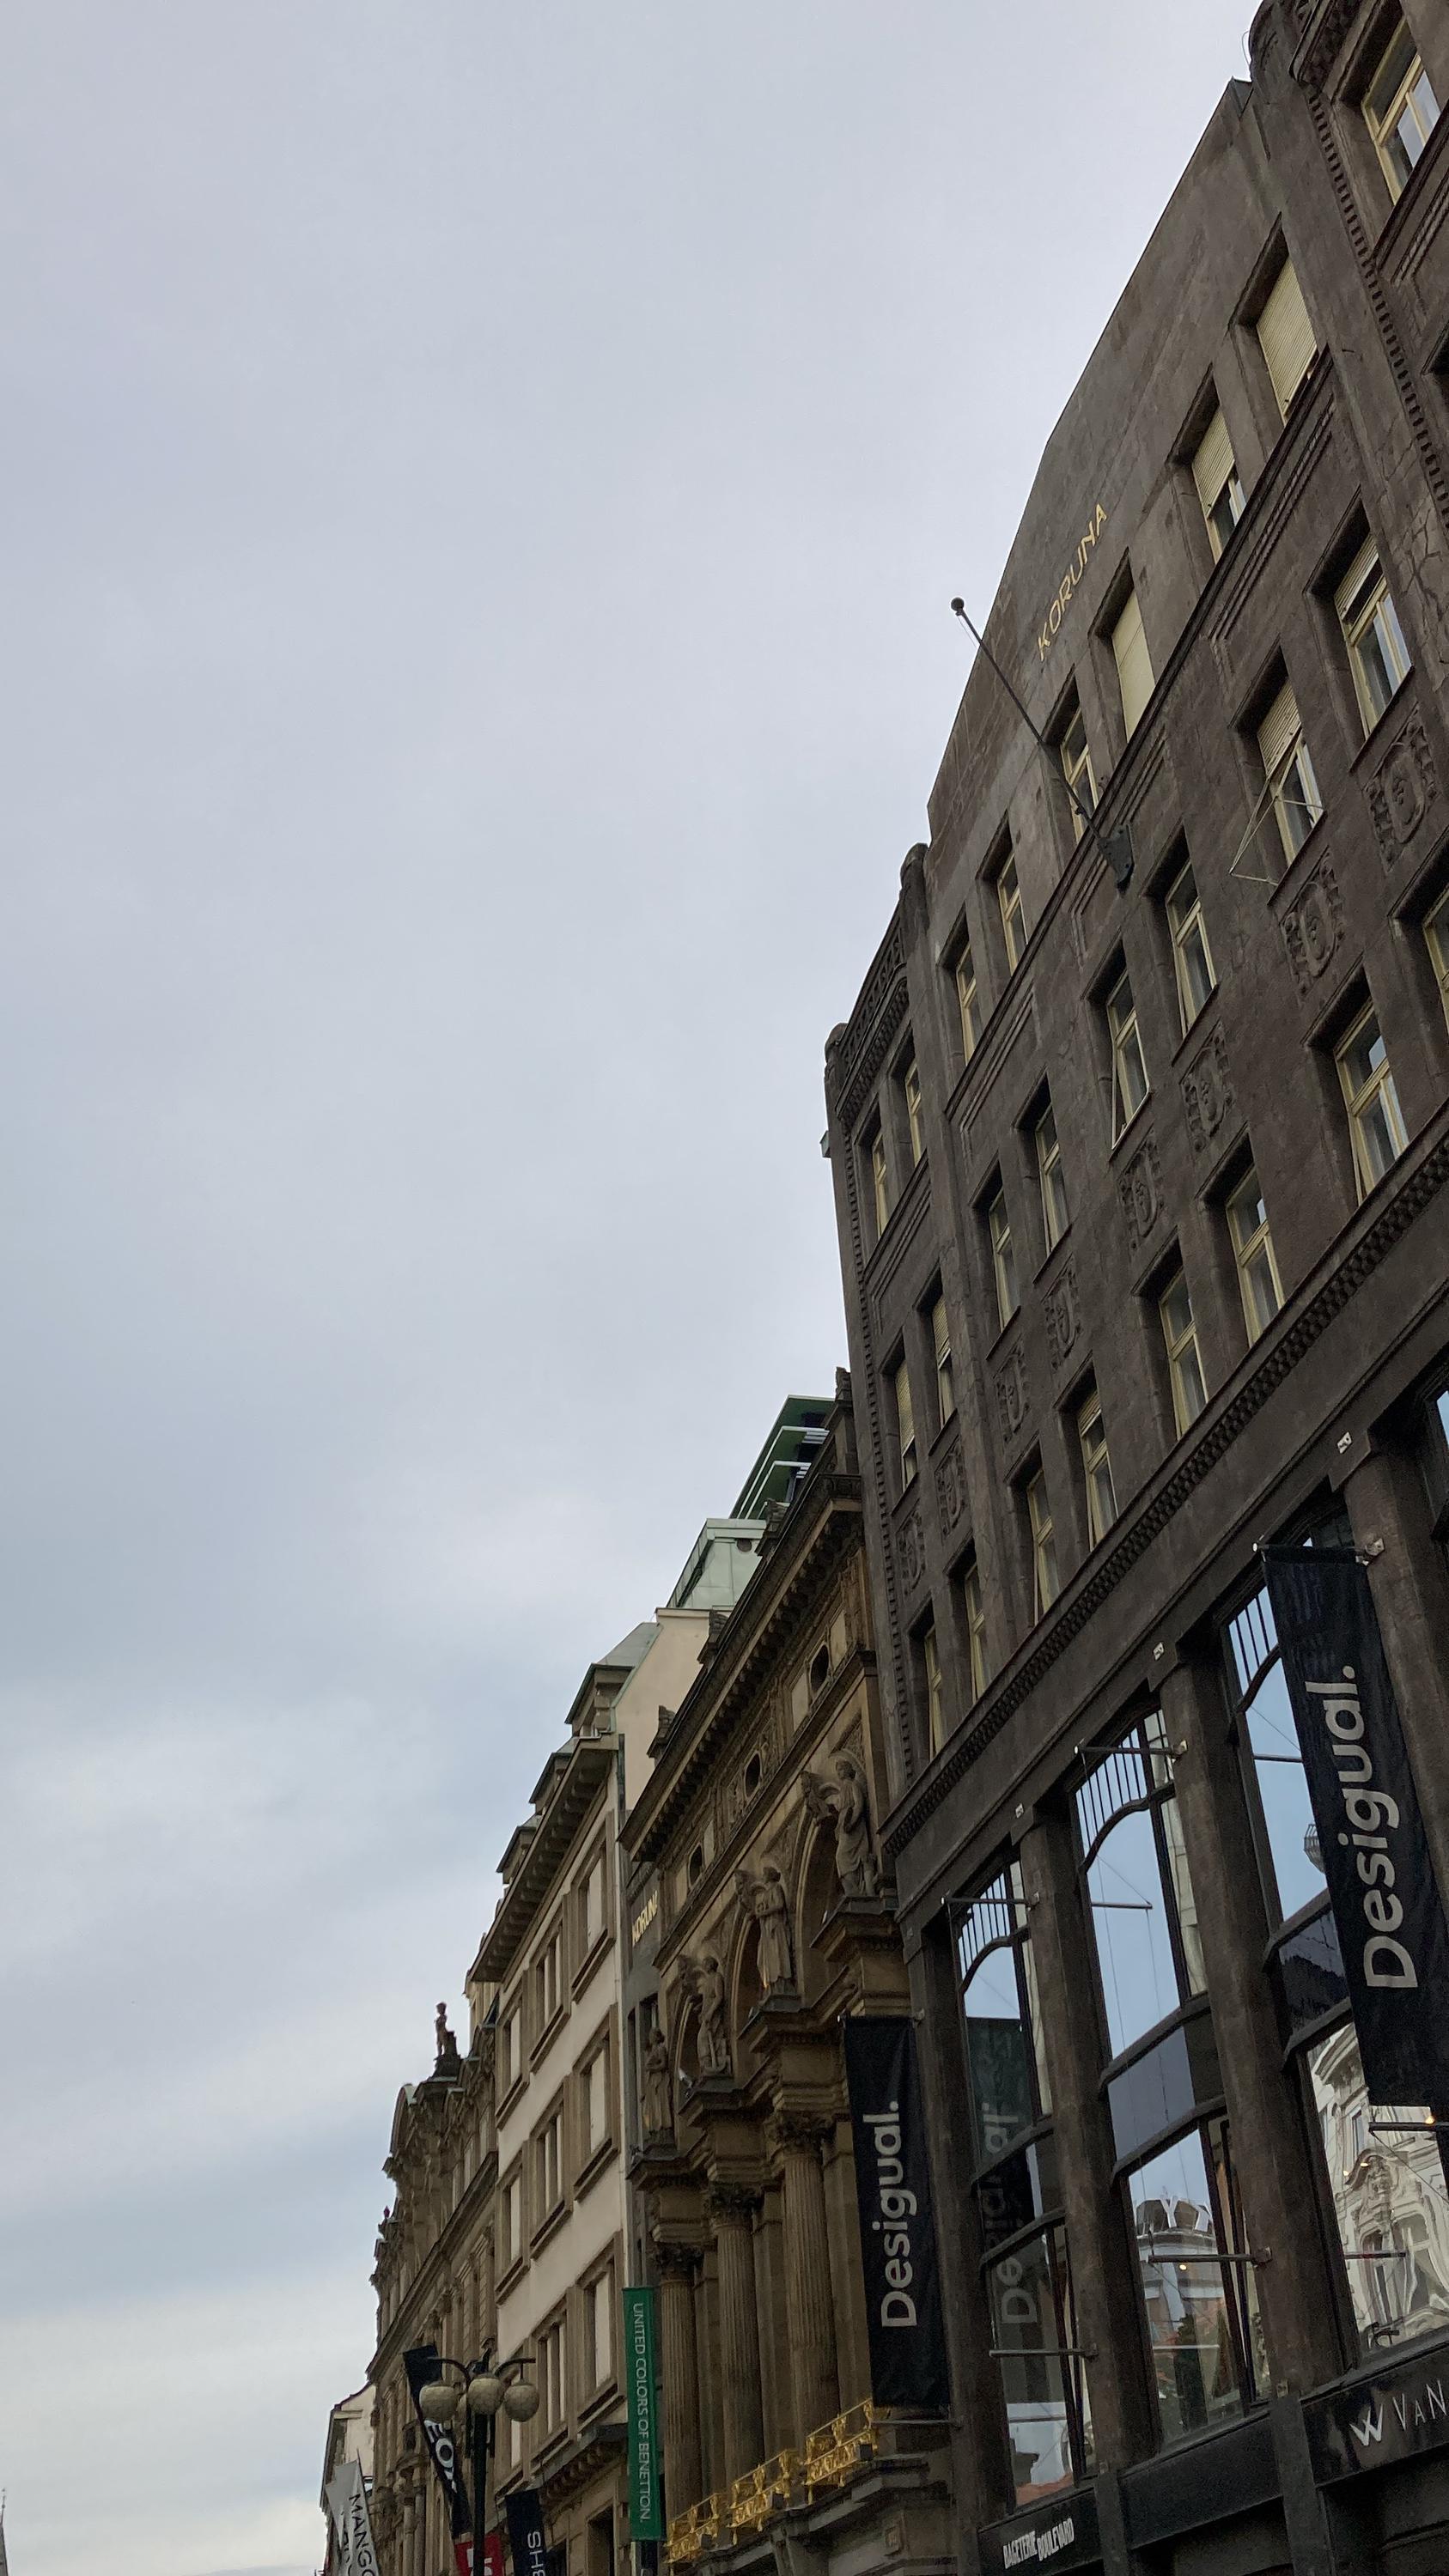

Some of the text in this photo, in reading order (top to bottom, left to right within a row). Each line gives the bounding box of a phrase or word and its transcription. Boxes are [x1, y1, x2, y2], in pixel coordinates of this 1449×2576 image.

[1038, 503, 1107, 661] KORUNA
[1305, 1665, 1418, 1989] Desigual.
[631, 1890, 658, 1947] KORUN
[862, 2101, 918, 2328] Desigual.
[633, 2303, 646, 2354] UNITED
[636, 2358, 648, 2415] COLORS
[638, 2419, 649, 2439] OF
